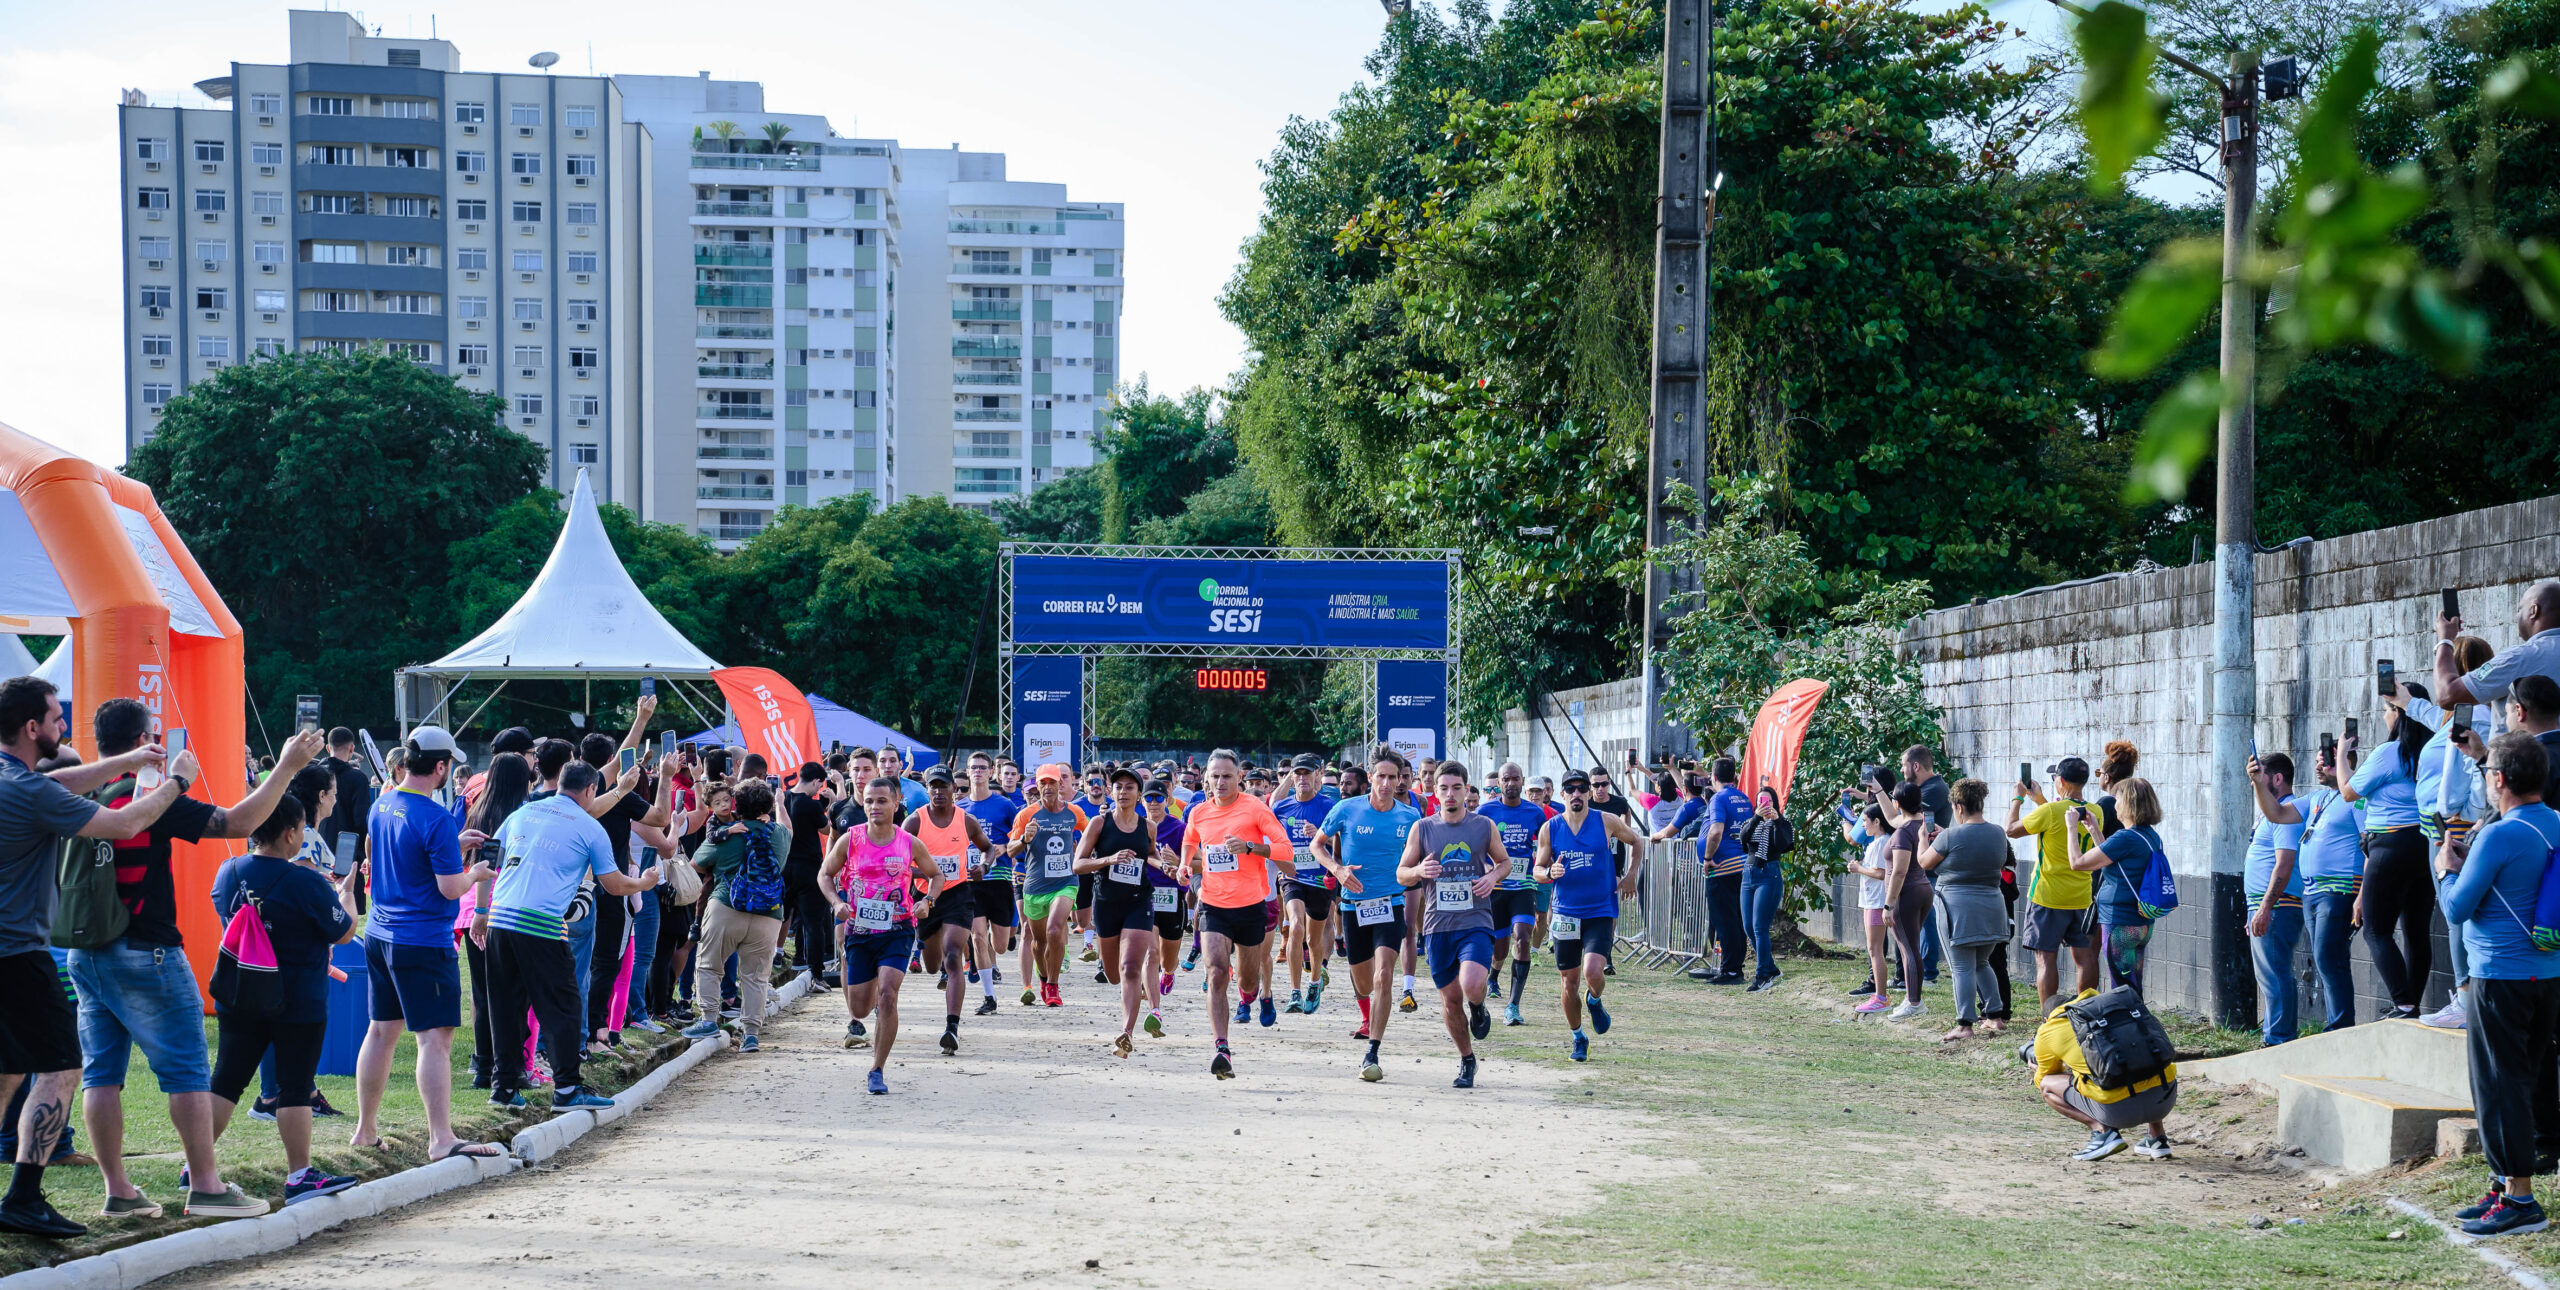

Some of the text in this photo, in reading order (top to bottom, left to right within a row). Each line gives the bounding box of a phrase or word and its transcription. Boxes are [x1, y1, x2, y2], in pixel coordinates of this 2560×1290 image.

[1214, 585, 1249, 596] CORRIDA
[1212, 597, 1264, 607] NACIONAL DO
[1328, 594, 1334, 606] A
[1335, 592, 1370, 606] INDÚSTRIA
[1043, 601, 1084, 613] CORRER
[1086, 601, 1105, 613] FAZ
[1120, 602, 1142, 614] BEM
[1328, 607, 1334, 618] A
[1335, 606, 1370, 619] INDÚSTRIA
[1371, 606, 1377, 620] É
[1377, 608, 1396, 619] MAIS
[1197, 670, 1267, 689] 000005
[753, 685, 782, 722] SESI
[1030, 739, 1052, 748] Firjan
[1394, 742, 1417, 751] Firjan
[1356, 826, 1374, 835] RUN
[1295, 854, 1313, 862] 1035
[1560, 851, 1583, 859] Firjan
[1118, 864, 1136, 876] 5121
[1442, 891, 1466, 901] 5276
[862, 908, 886, 920] 5086
[1362, 907, 1387, 917] 5082
